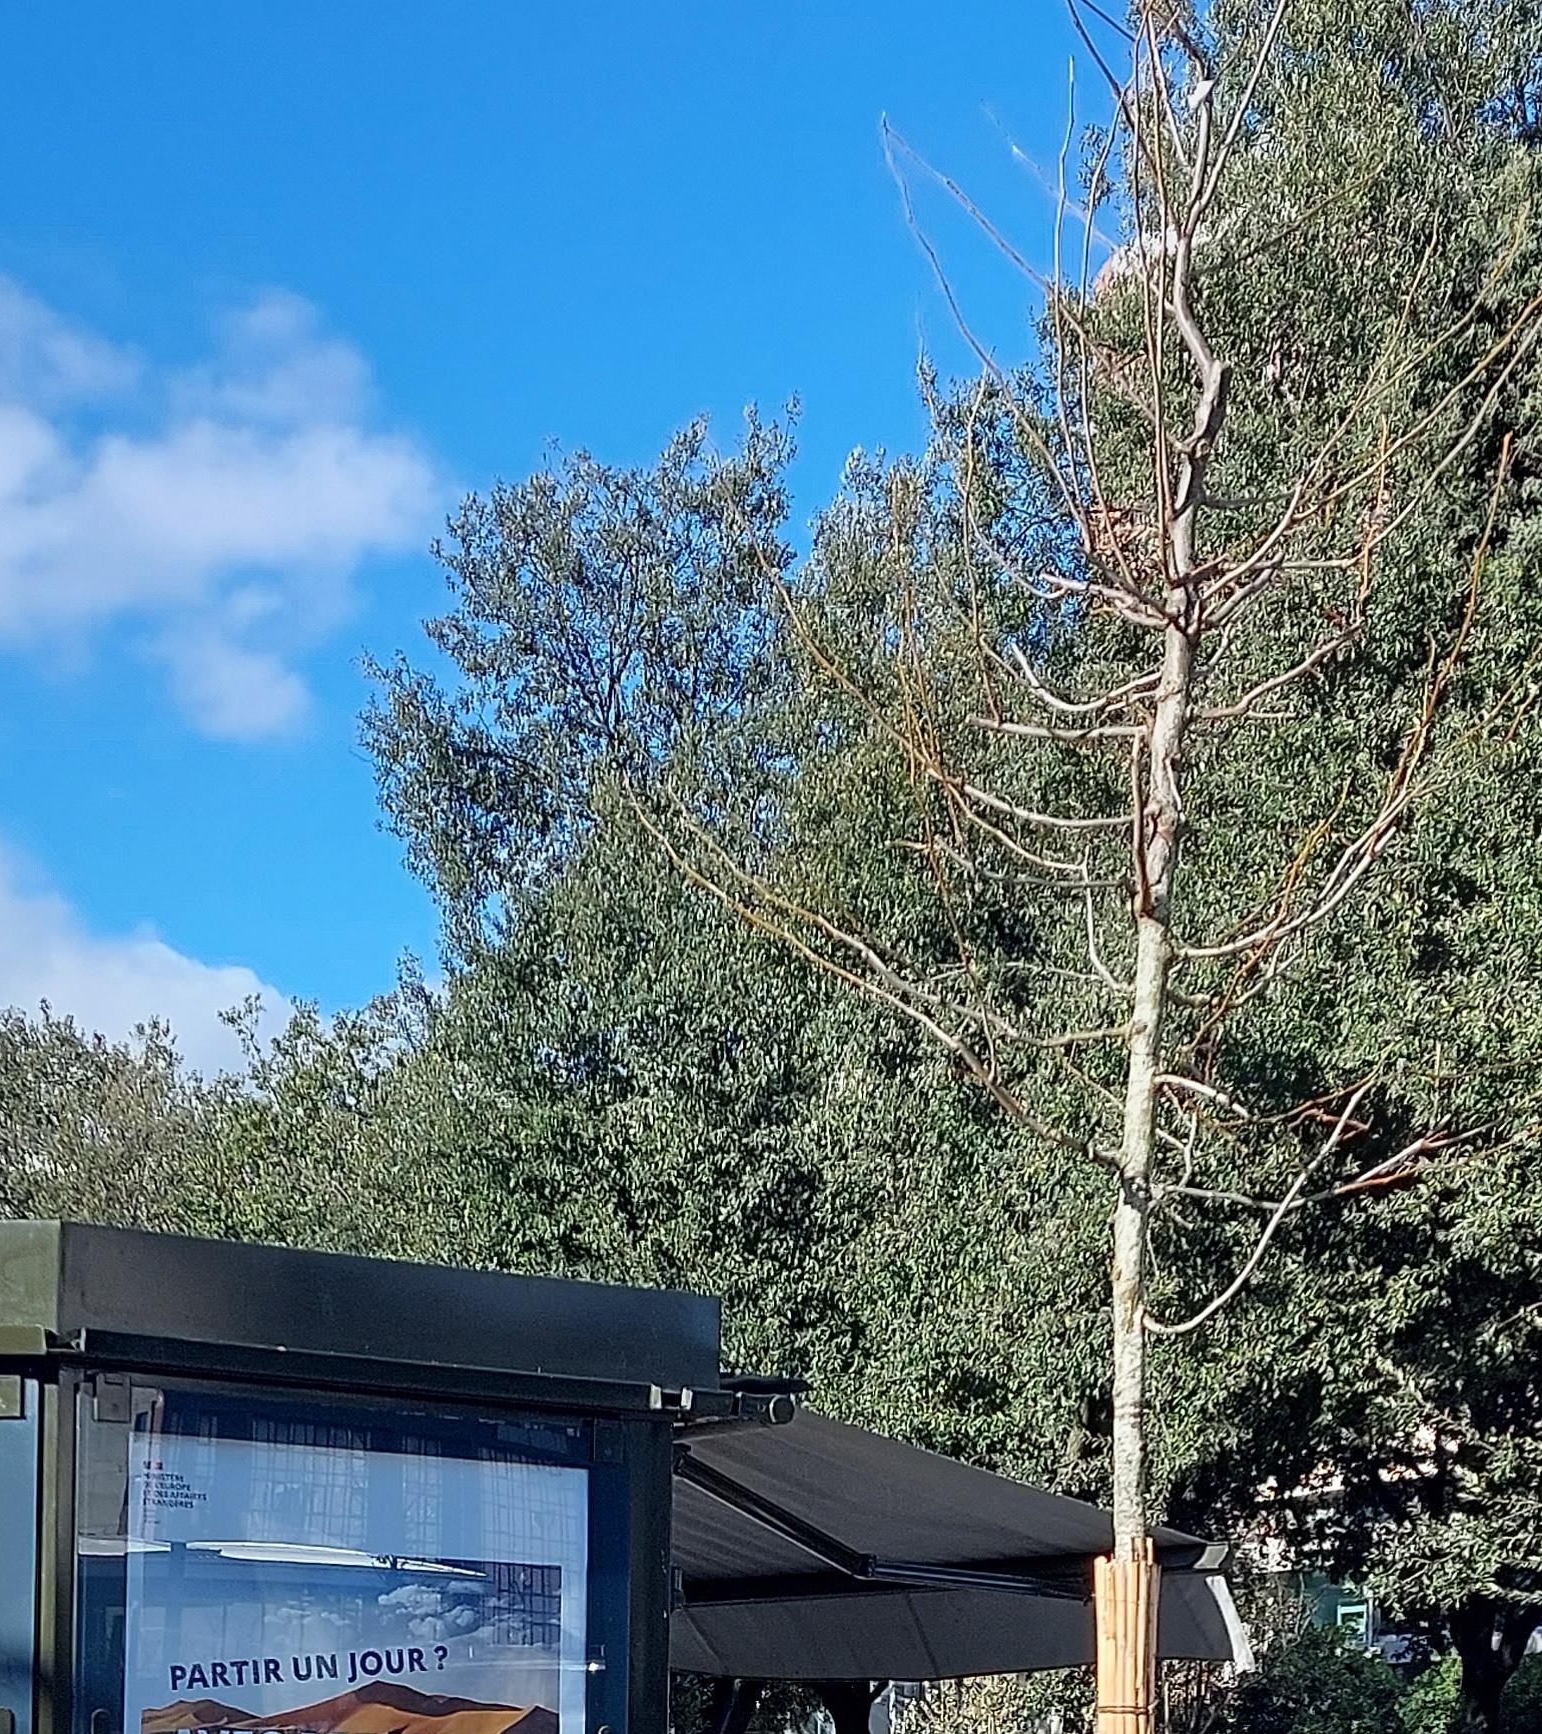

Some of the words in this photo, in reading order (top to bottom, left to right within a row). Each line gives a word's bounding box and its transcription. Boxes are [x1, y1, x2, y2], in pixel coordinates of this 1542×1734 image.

[170, 1658, 284, 1691] PARTIR
[292, 1654, 339, 1681] UN
[348, 1648, 427, 1683] JOUR
